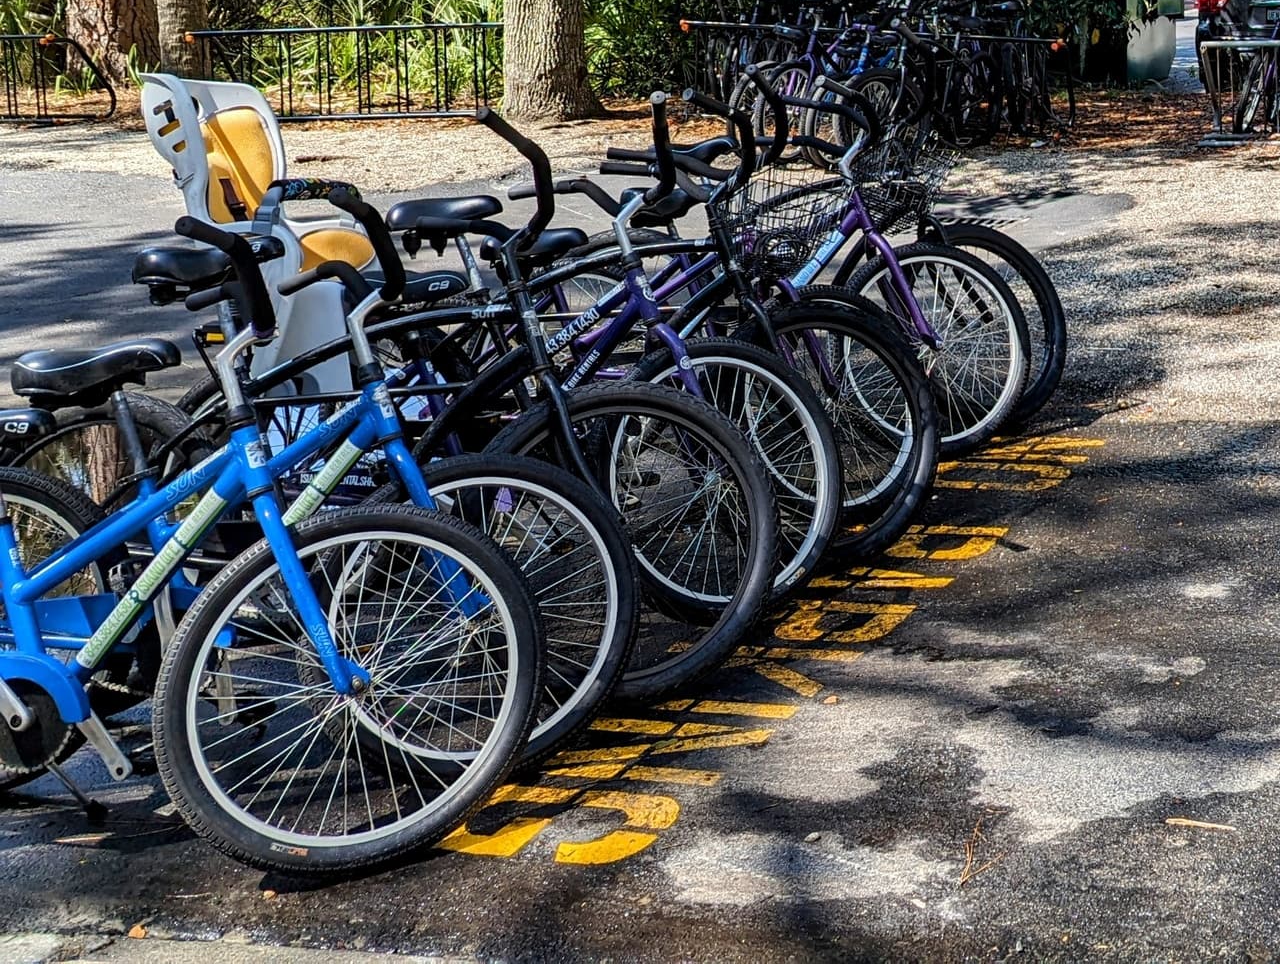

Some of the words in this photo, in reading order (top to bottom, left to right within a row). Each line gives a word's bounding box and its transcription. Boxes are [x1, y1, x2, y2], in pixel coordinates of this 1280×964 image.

[428, 280, 449, 291] C9
[542, 304, 601, 357] 43.384.1430
[566, 371, 582, 388] BIKE
[575, 348, 602, 375] RENTALS
[4, 422, 30, 434] C9
[134, 558, 169, 595] ISLAND
[157, 540, 182, 566] LIFE
[80, 598, 136, 658] 843.384.1430
